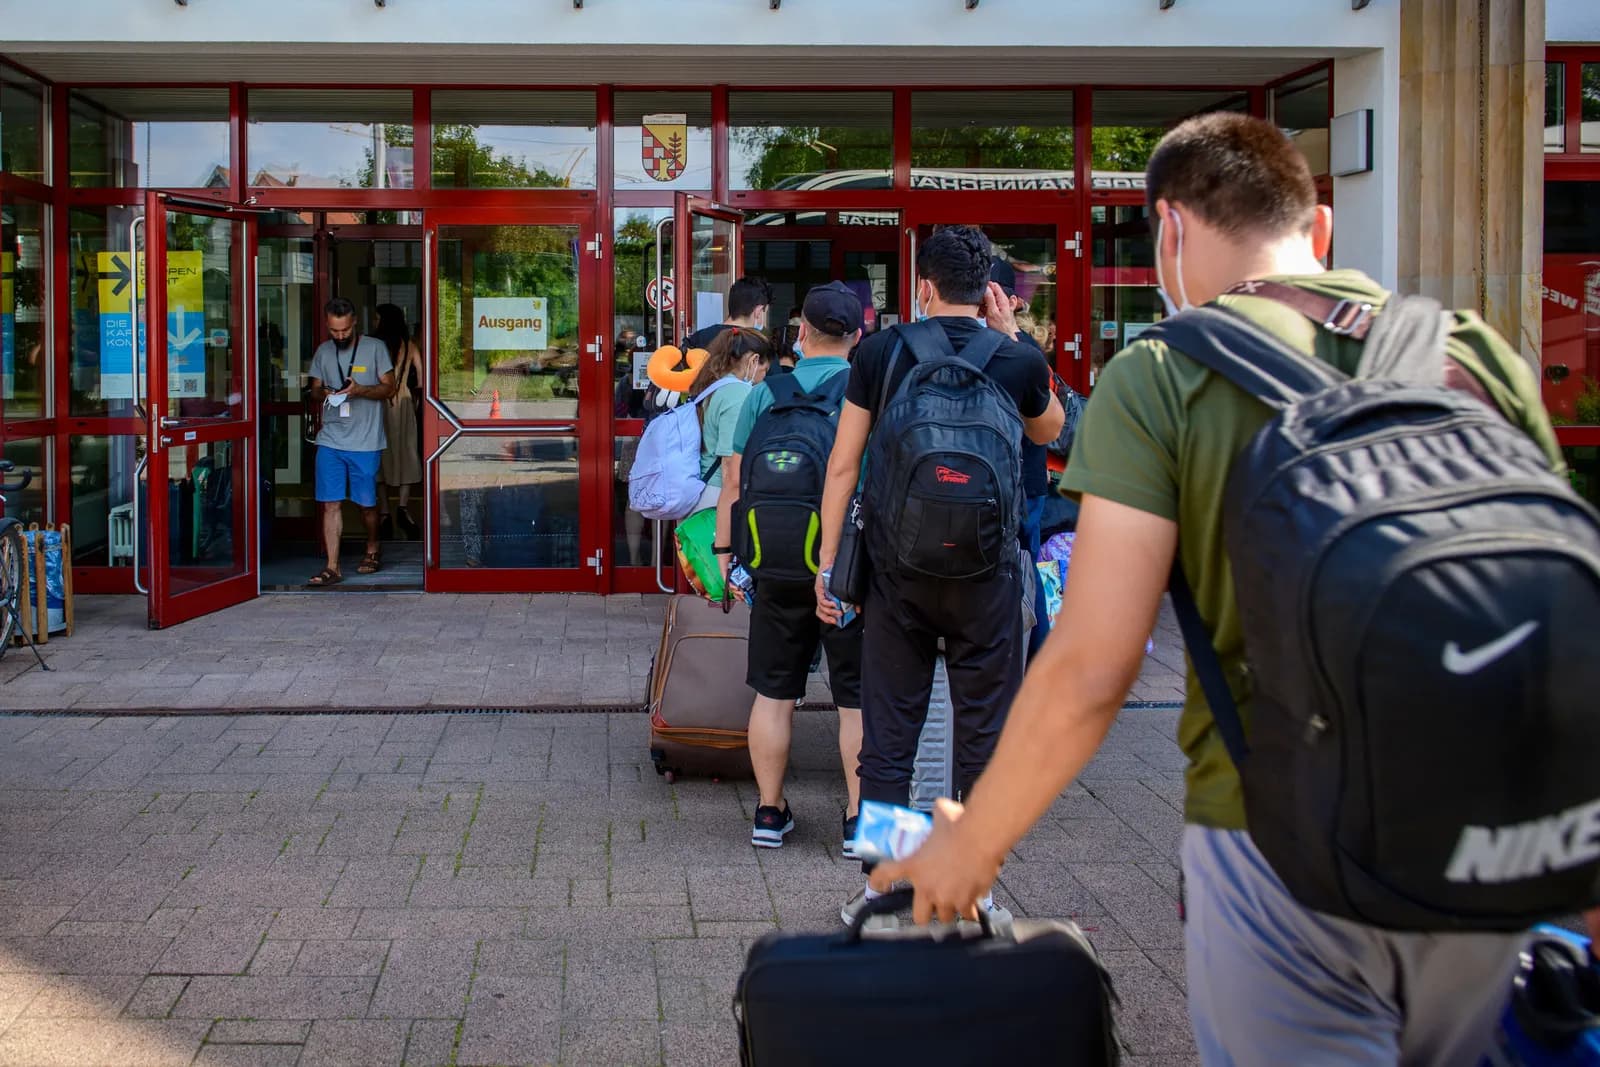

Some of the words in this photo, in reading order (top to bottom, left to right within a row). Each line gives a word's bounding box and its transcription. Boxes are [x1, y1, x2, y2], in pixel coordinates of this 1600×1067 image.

[106, 319, 128, 328] DIE
[478, 315, 543, 332] Ausgang
[1444, 798, 1600, 884] NIKE
